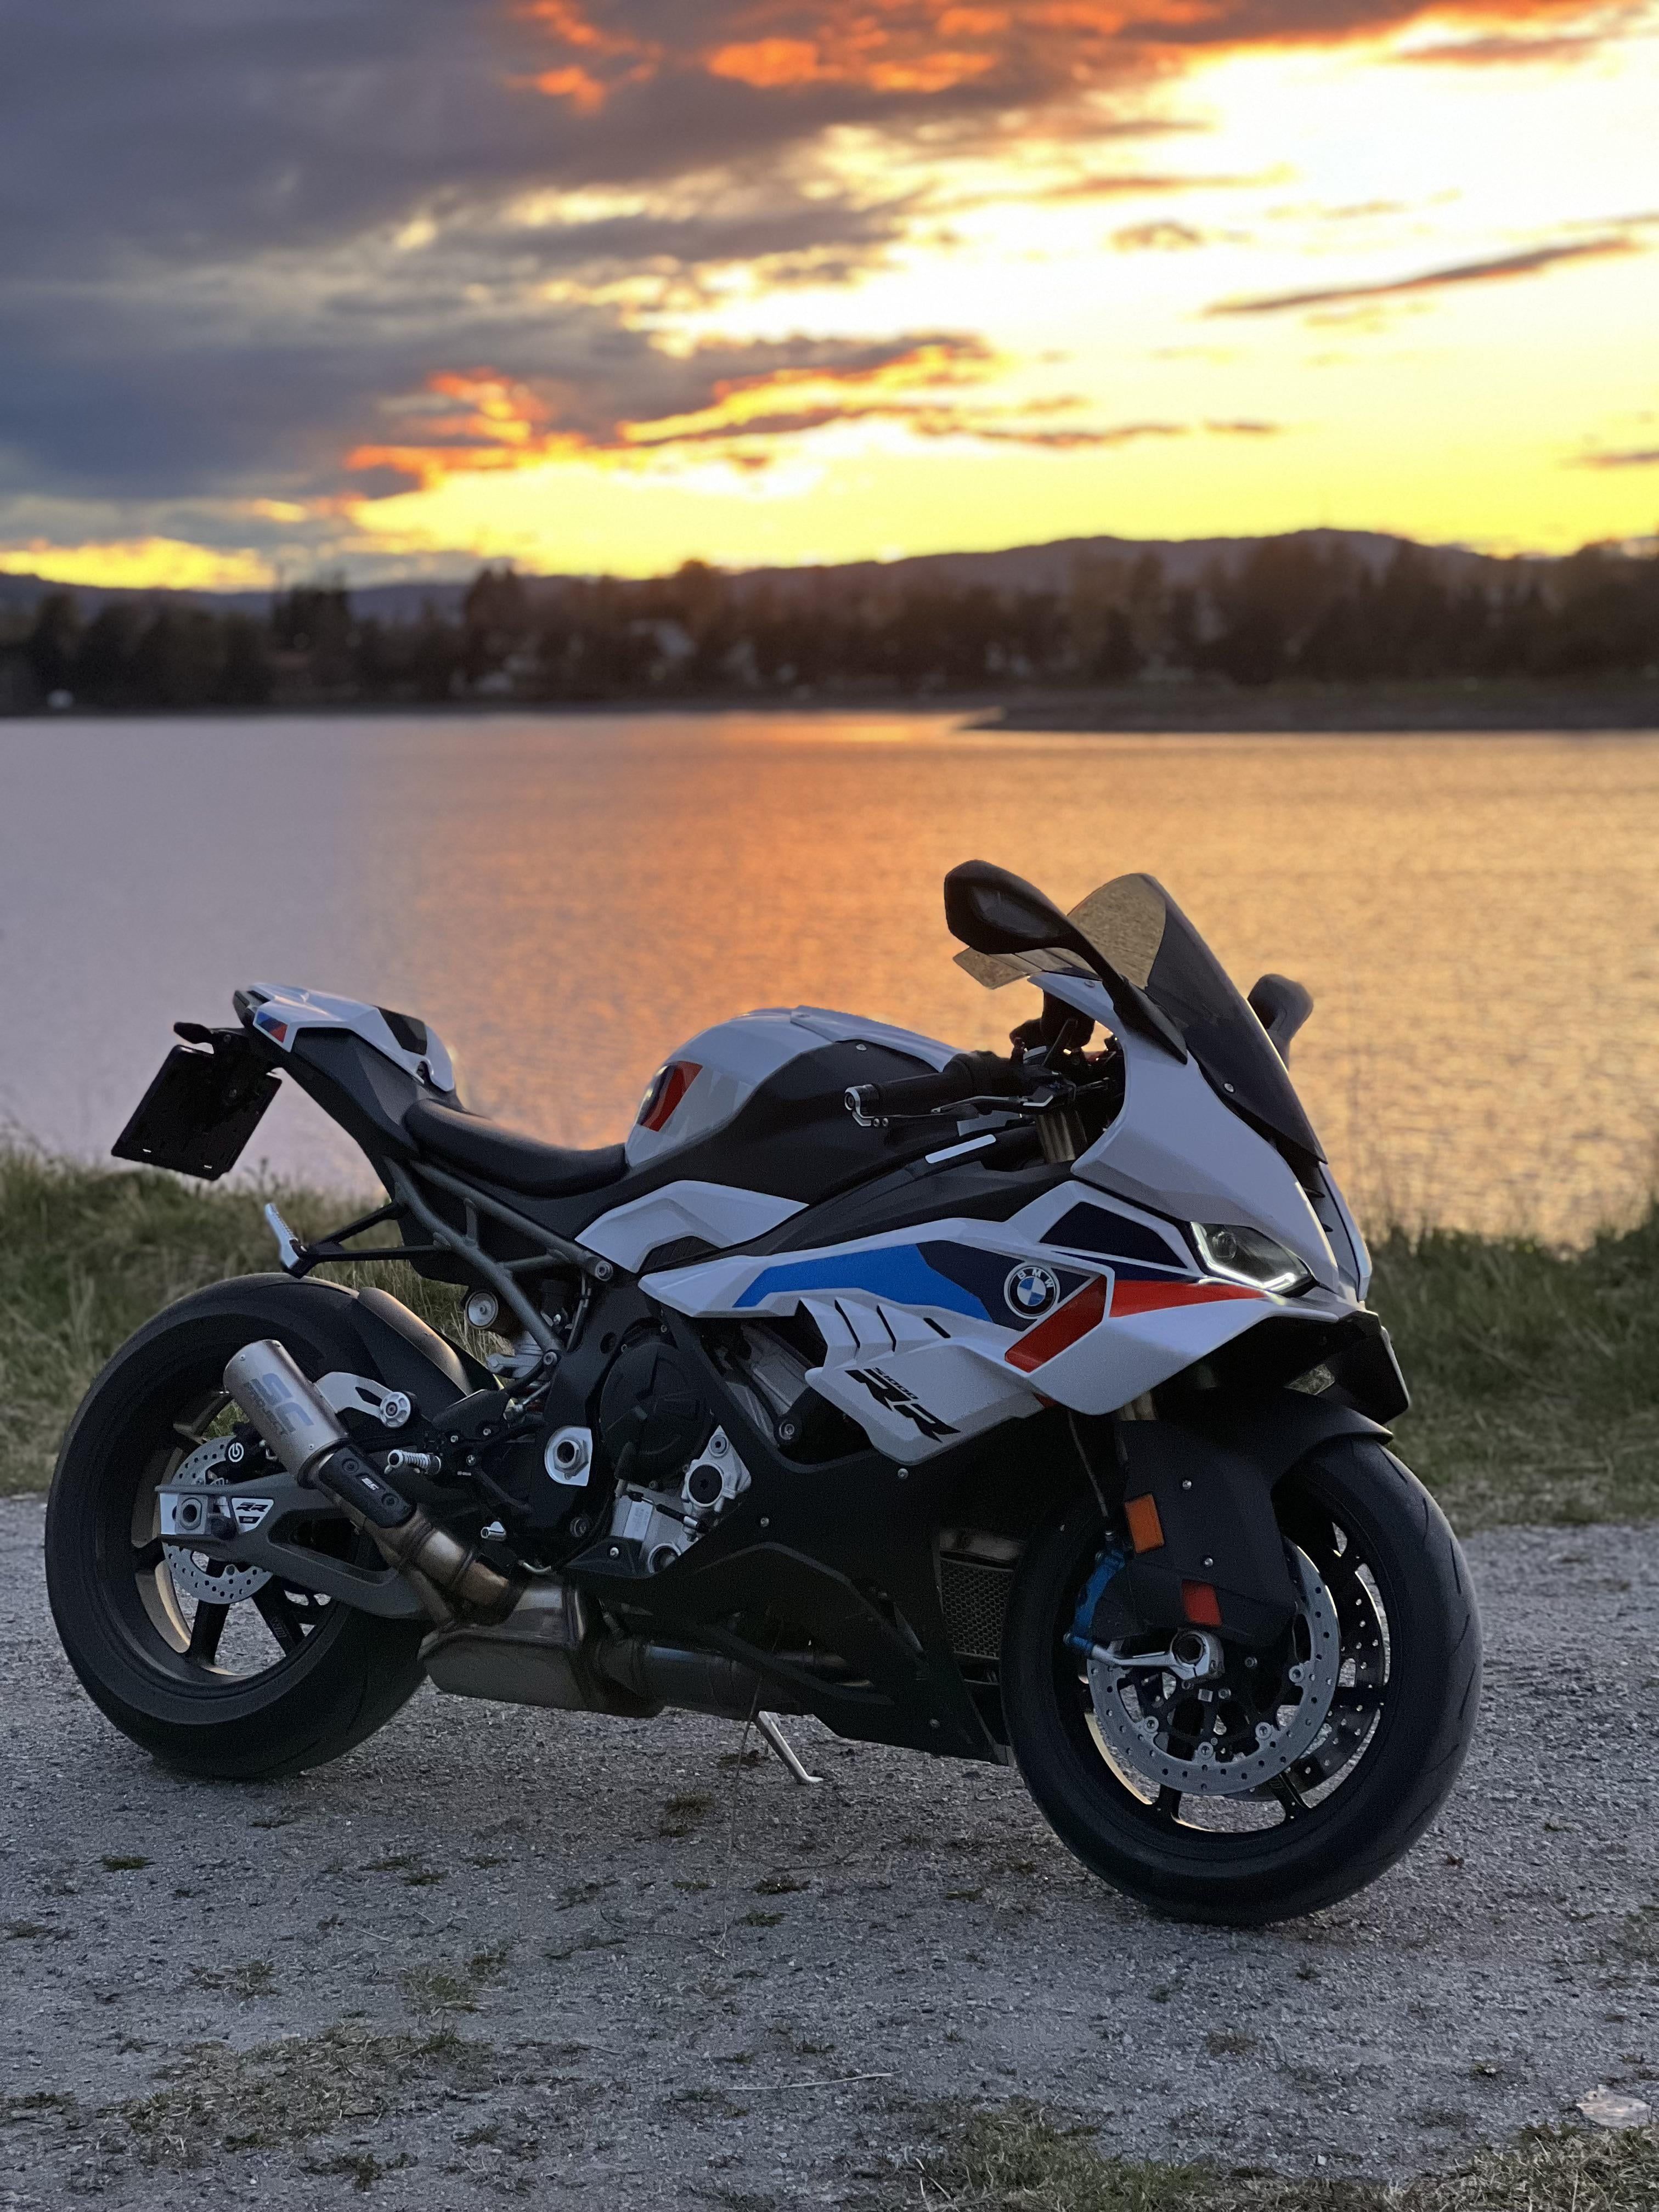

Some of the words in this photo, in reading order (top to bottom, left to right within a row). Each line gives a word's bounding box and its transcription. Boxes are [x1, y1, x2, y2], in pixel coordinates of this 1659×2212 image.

[1017, 1268, 1054, 1288] BMW
[872, 1367, 919, 1400] S1000
[250, 1373, 315, 1433] SC
[844, 1368, 961, 1443] RR
[236, 1504, 269, 1512] RR
